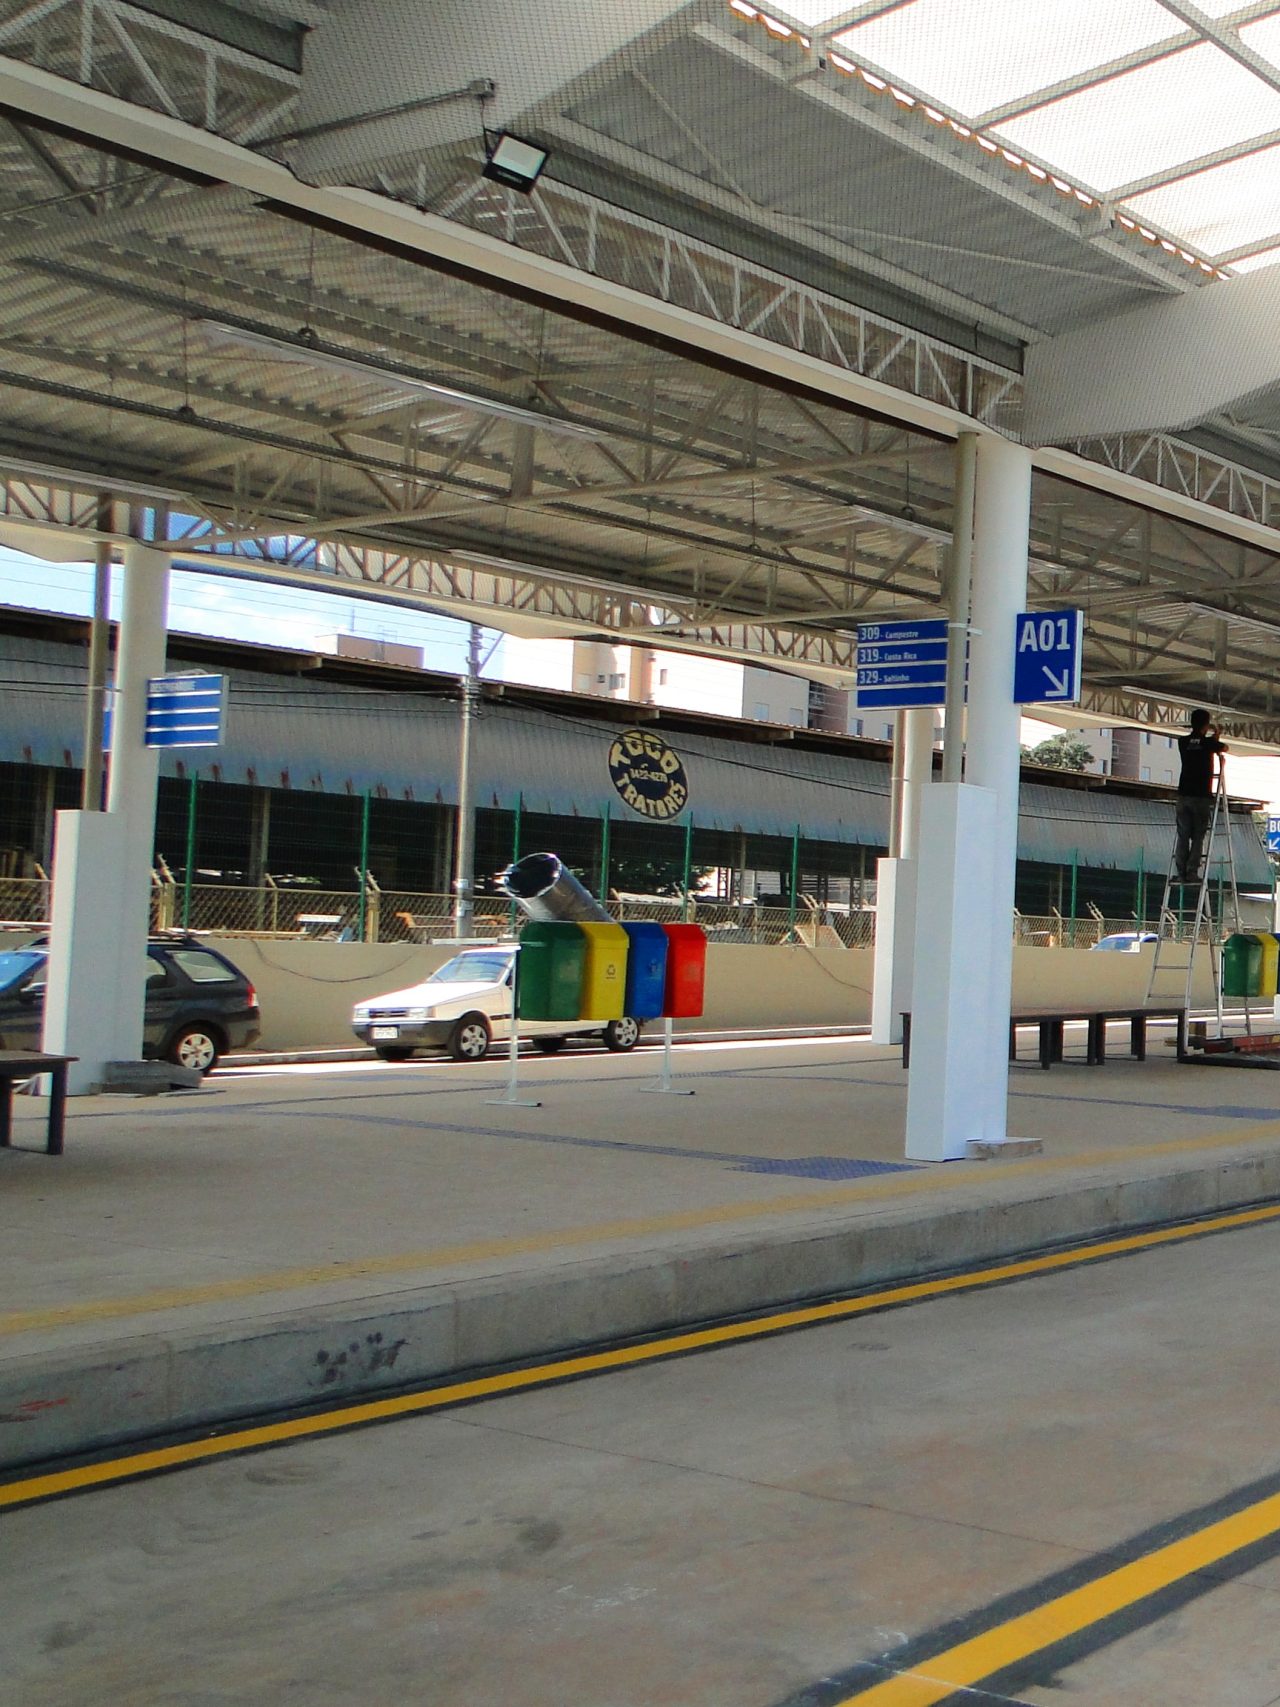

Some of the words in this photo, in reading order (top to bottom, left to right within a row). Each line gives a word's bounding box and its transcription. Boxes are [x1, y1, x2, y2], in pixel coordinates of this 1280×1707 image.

[1018, 618, 1071, 653] A01
[610, 732, 680, 774] TOCO
[615, 772, 687, 817] TRATORES
